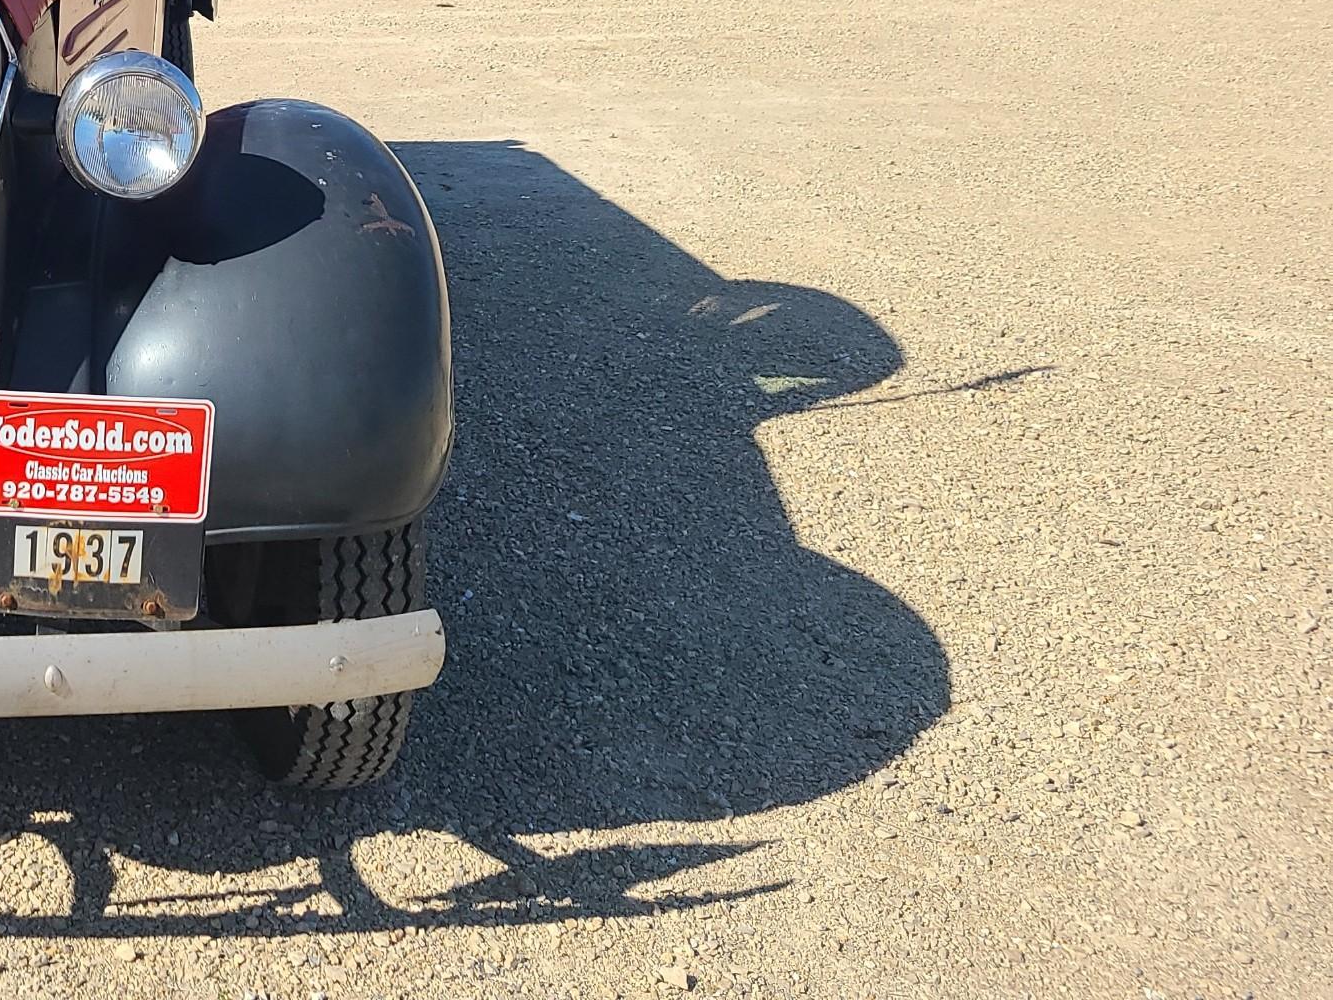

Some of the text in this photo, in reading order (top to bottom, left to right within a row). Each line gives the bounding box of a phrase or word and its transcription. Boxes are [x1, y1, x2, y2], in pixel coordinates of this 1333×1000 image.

[25, 460, 148, 484] Classic Car Auctions
[2, 481, 164, 504] 920-787-5549
[25, 530, 137, 578] 1937
